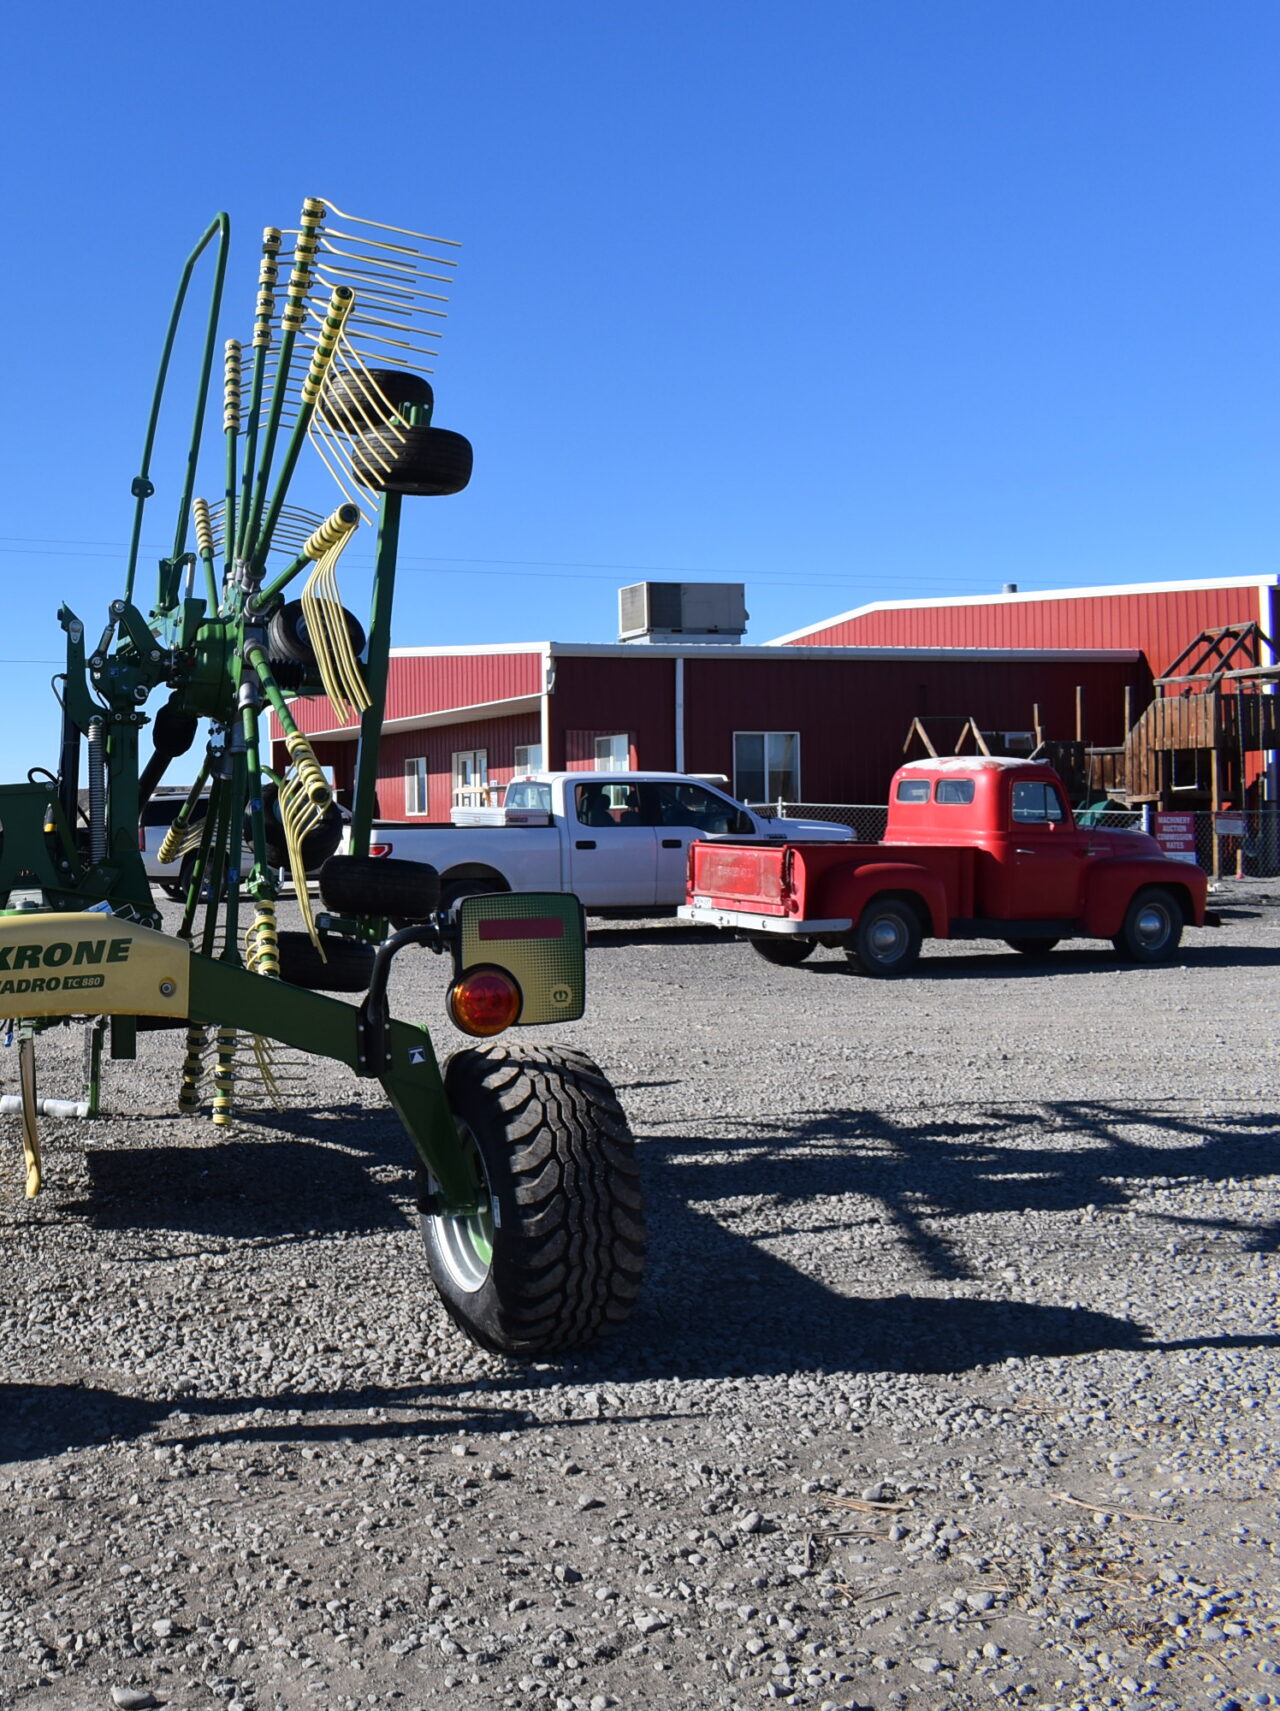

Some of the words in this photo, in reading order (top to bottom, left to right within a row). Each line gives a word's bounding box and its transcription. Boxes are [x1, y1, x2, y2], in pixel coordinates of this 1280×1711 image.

[1158, 816, 1190, 824] MACHINERY
[1157, 833, 1193, 841] COMMISSION
[67, 978, 80, 987] TC
[81, 977, 101, 986] 880
